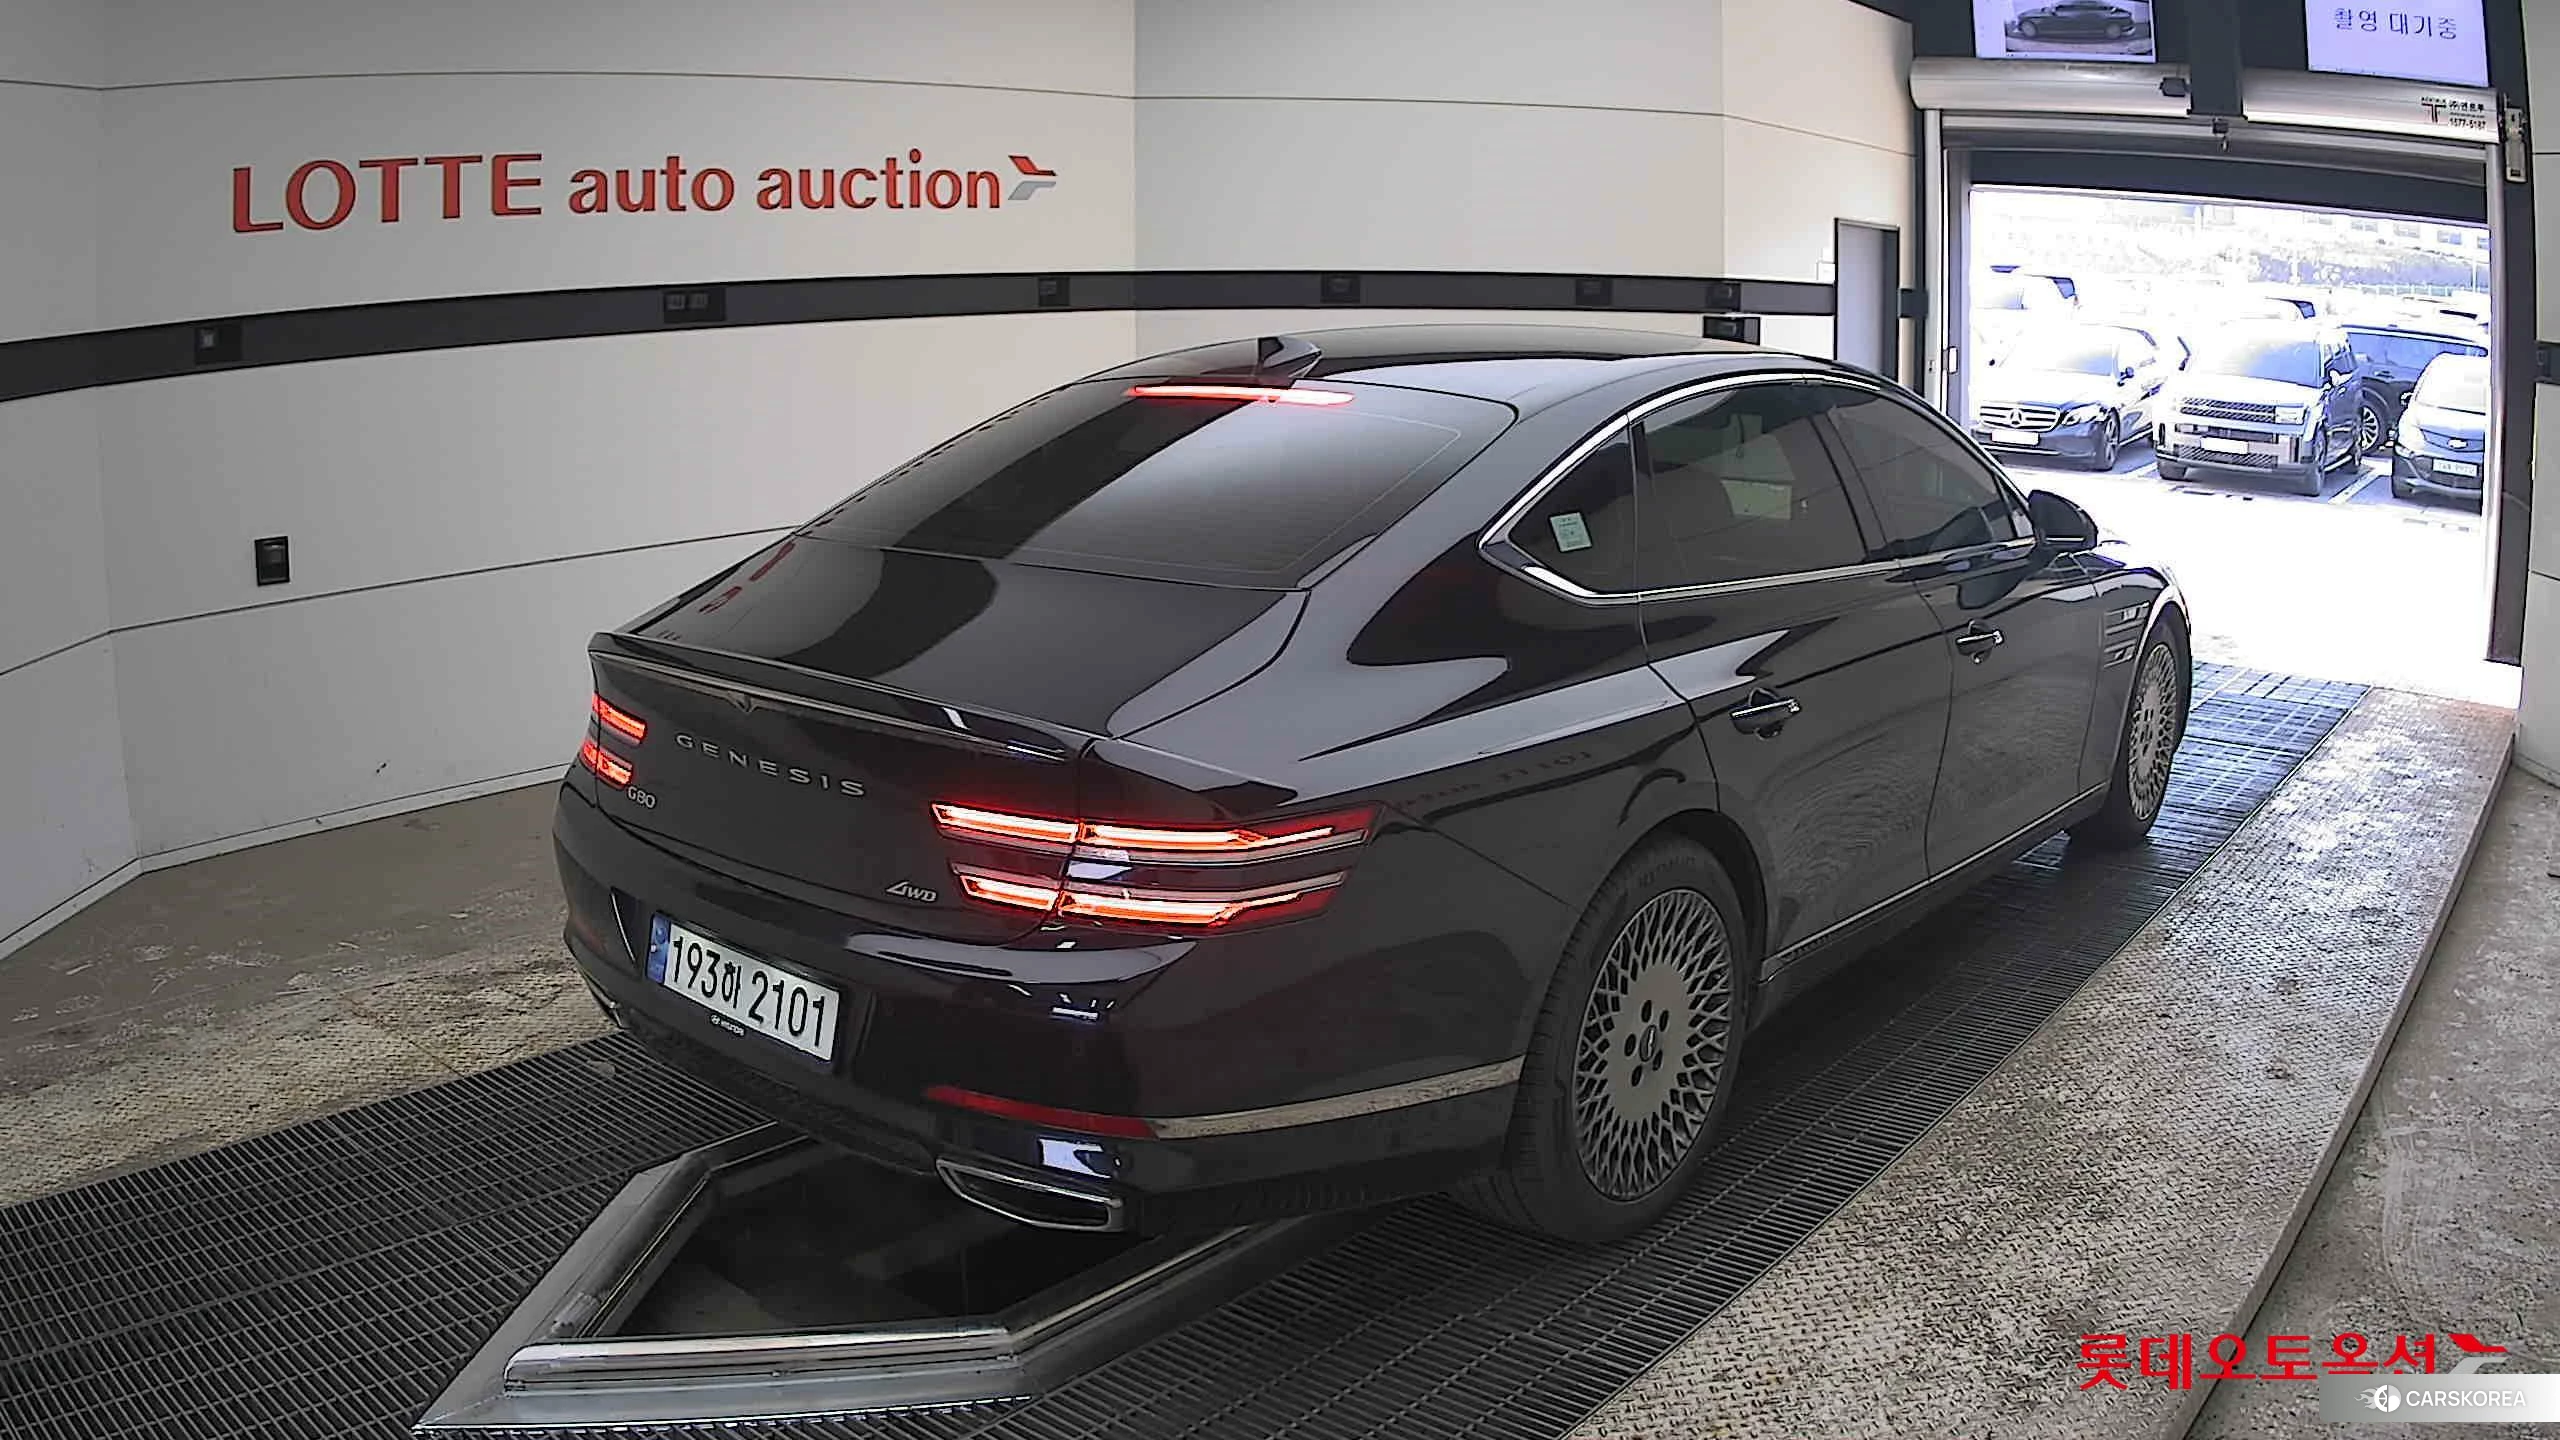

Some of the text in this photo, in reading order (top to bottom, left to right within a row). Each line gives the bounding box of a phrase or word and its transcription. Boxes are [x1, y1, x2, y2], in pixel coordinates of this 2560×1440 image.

[2335, 7, 2456, 39] 촬영 대기중
[233, 148, 1001, 233] LOTTE auto auction
[675, 733, 865, 797] GENESIS
[627, 785, 656, 809] G80
[886, 880, 937, 903] 4WD
[748, 970, 826, 1048] 2101
